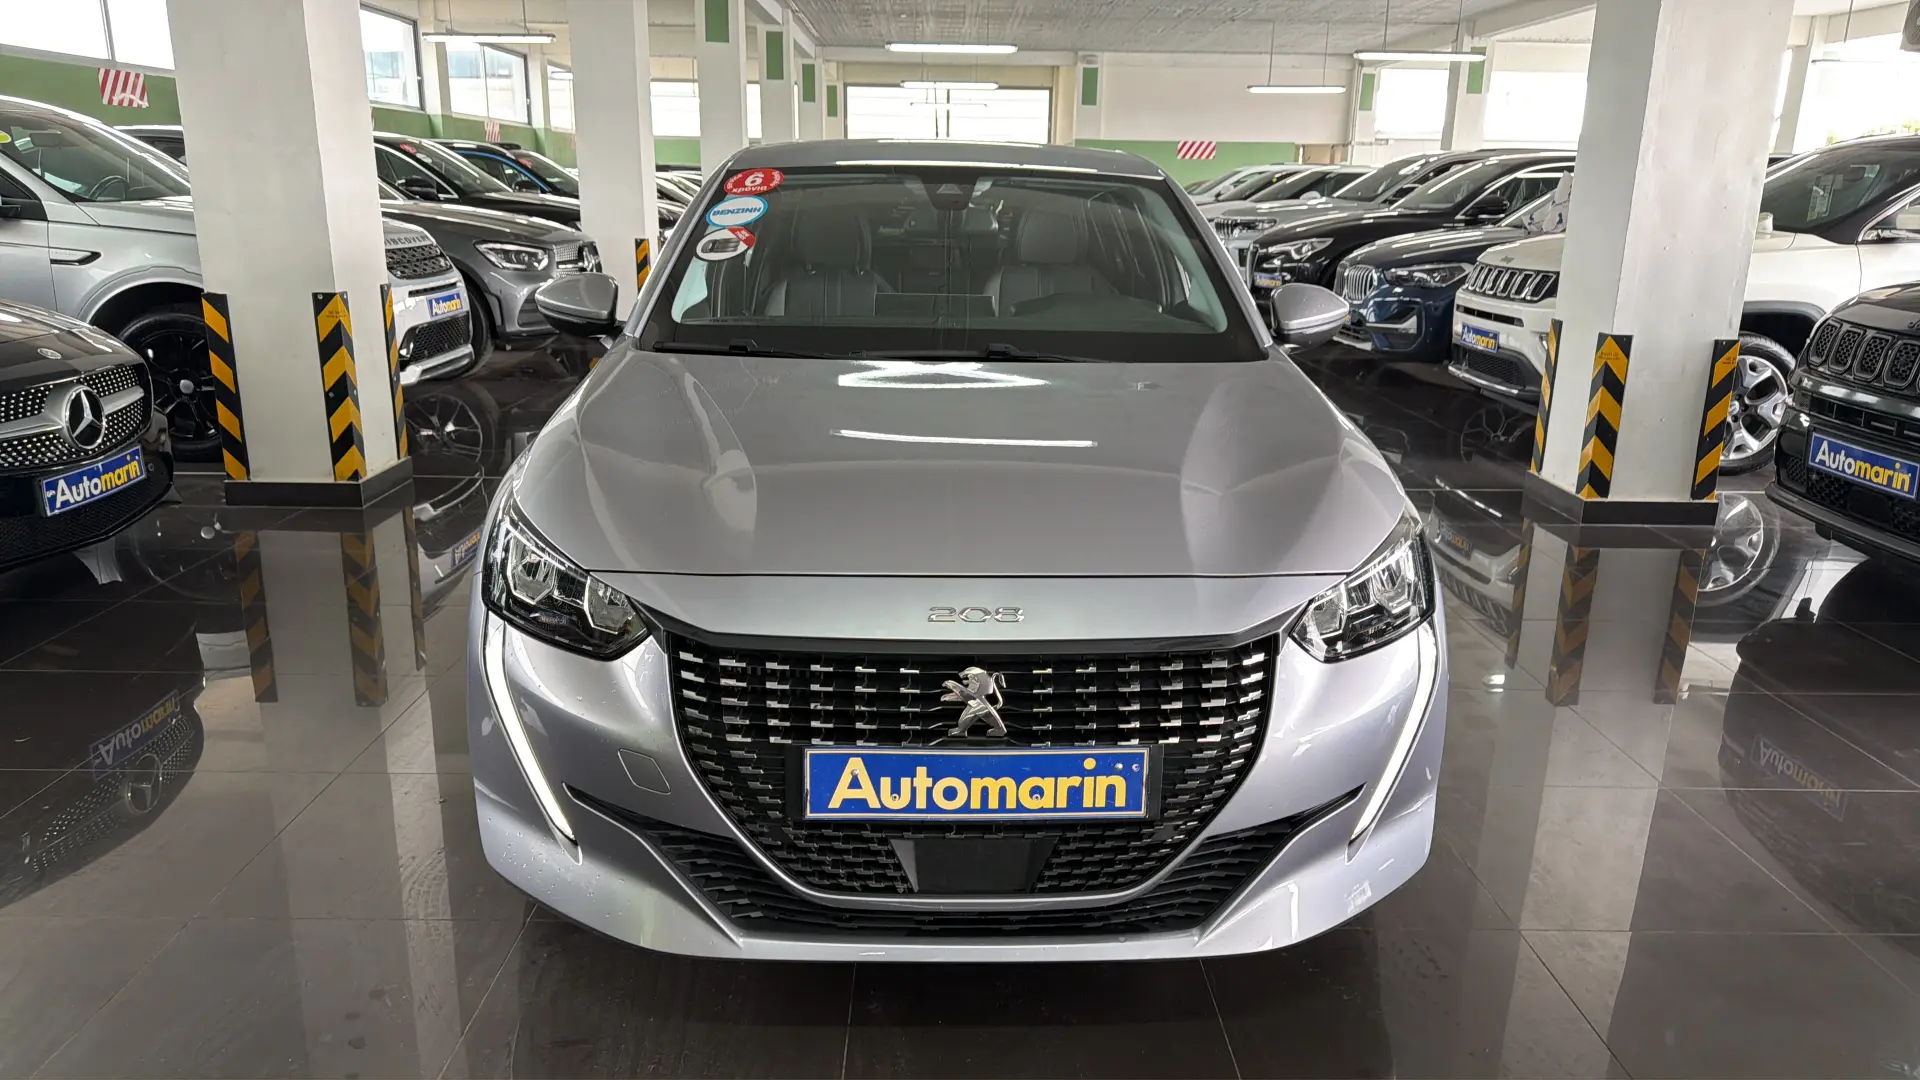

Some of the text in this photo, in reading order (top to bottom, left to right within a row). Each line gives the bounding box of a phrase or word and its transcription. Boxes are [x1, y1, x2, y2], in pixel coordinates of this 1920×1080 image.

[744, 173, 765, 187] 6
[56, 455, 141, 508] Automarin
[1814, 439, 1911, 492] Automarin
[927, 606, 1025, 623] 208
[828, 757, 1127, 810] Automarin
